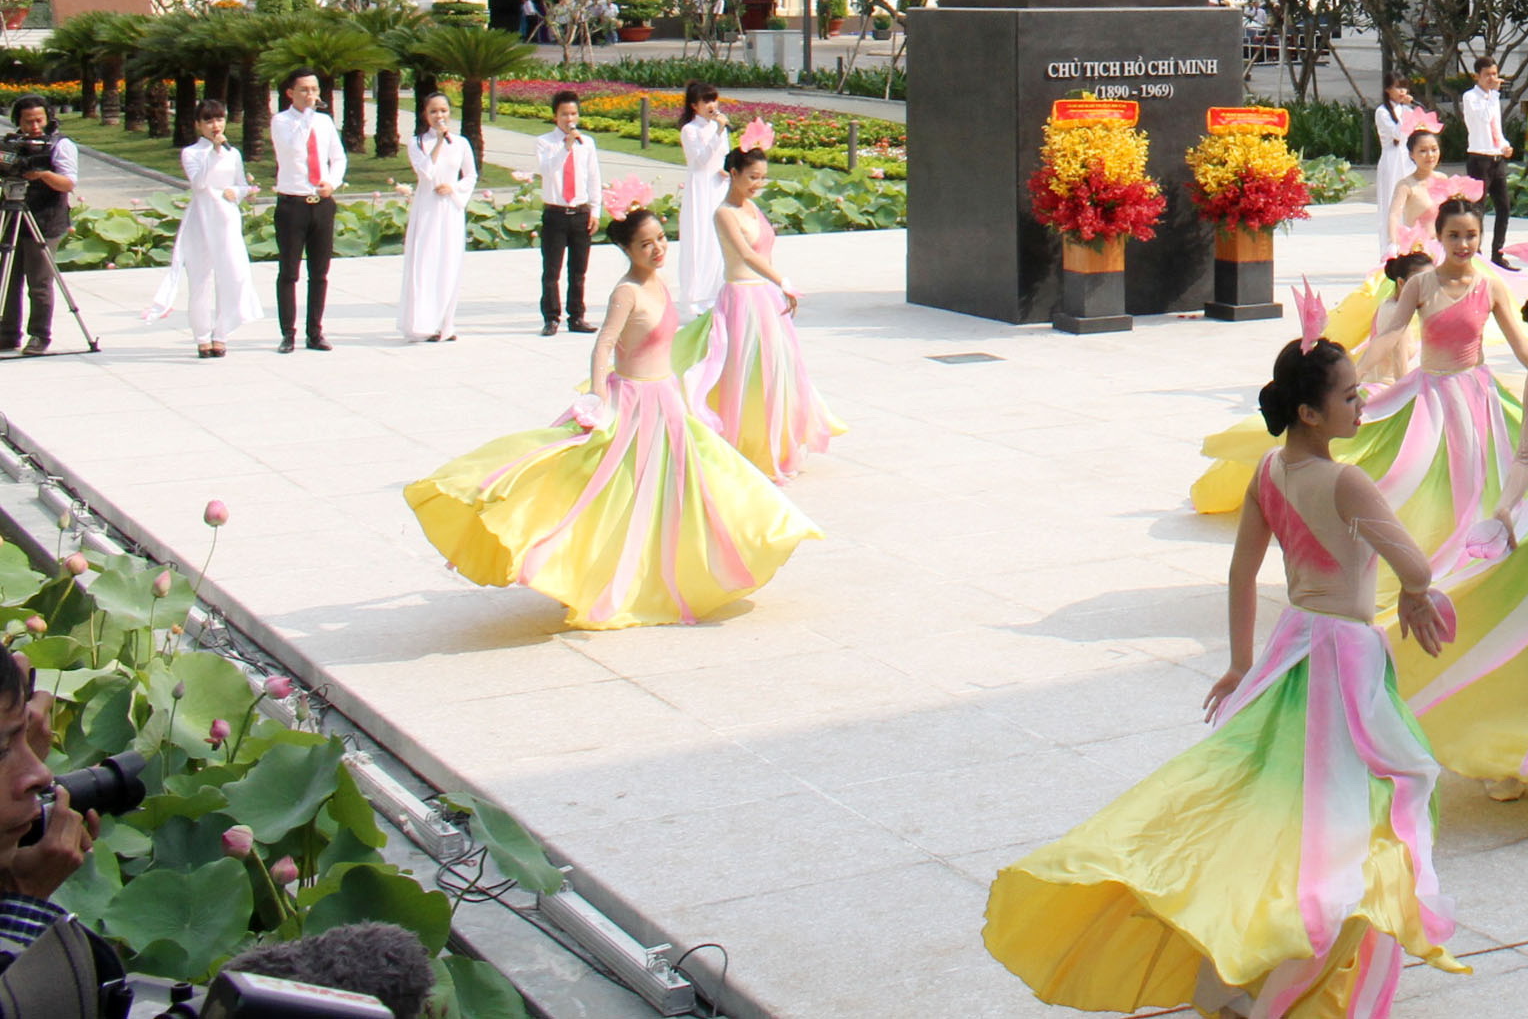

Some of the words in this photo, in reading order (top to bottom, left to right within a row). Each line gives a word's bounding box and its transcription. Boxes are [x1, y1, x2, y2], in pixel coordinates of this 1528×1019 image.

[1047, 57, 1081, 78] CHỦ
[1084, 61, 1121, 79] TỊCH
[1147, 57, 1175, 76] CHÍ
[1178, 59, 1218, 75] MINH
[1095, 84, 1129, 99] (1890
[1140, 83, 1174, 99] 1969)
